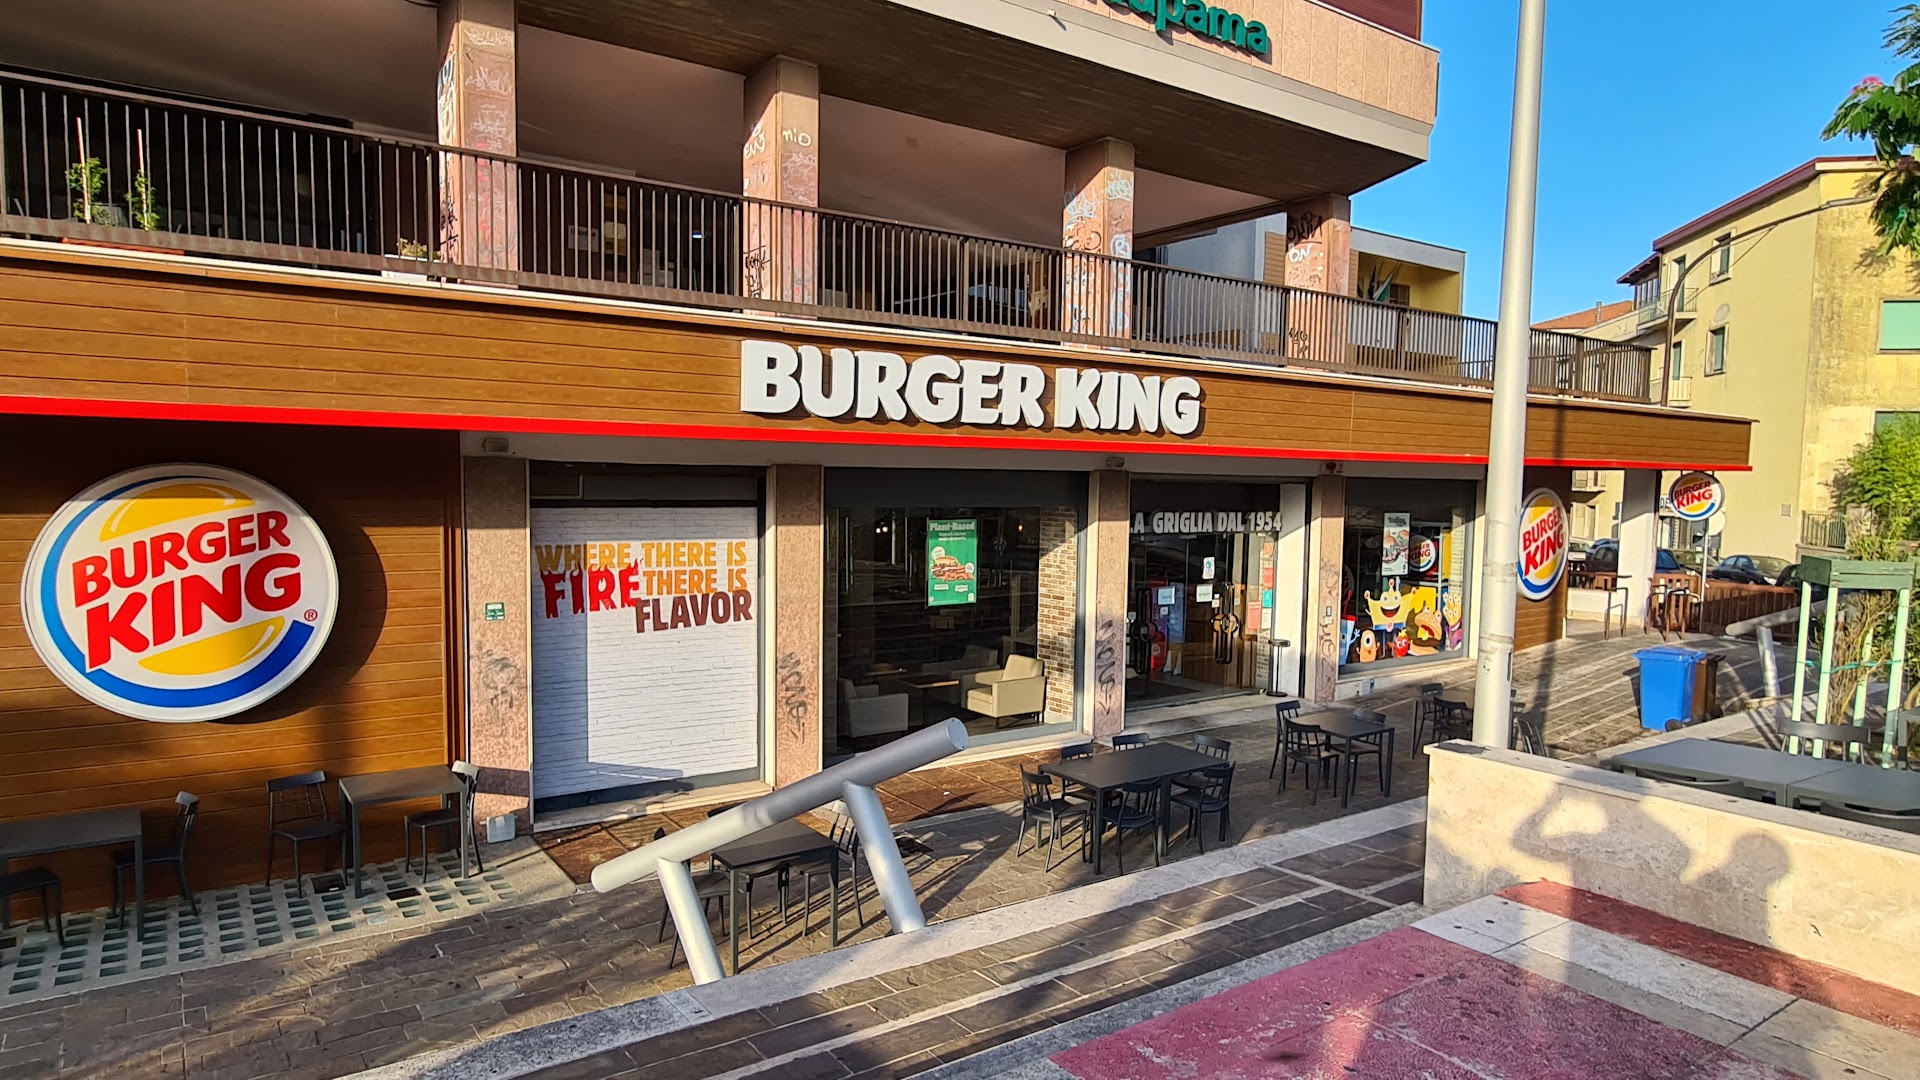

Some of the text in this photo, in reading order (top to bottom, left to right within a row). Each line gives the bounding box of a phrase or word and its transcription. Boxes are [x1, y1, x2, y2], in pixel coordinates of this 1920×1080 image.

[740, 339, 1201, 436] BURGER KING
[1674, 480, 1711, 499] BURGER
[1677, 489, 1713, 509] KING
[929, 522, 975, 531] Plant-Based
[1130, 511, 1282, 534] A GRIGLIA DAL 1954
[1523, 506, 1562, 552] BURGER
[72, 510, 291, 608] BURGER
[535, 541, 747, 571] WHERE THERE IS
[1524, 523, 1564, 577] KING
[86, 552, 301, 670] KING
[540, 558, 748, 619] FIRE THERE IS
[635, 589, 753, 634] FLAVOR
